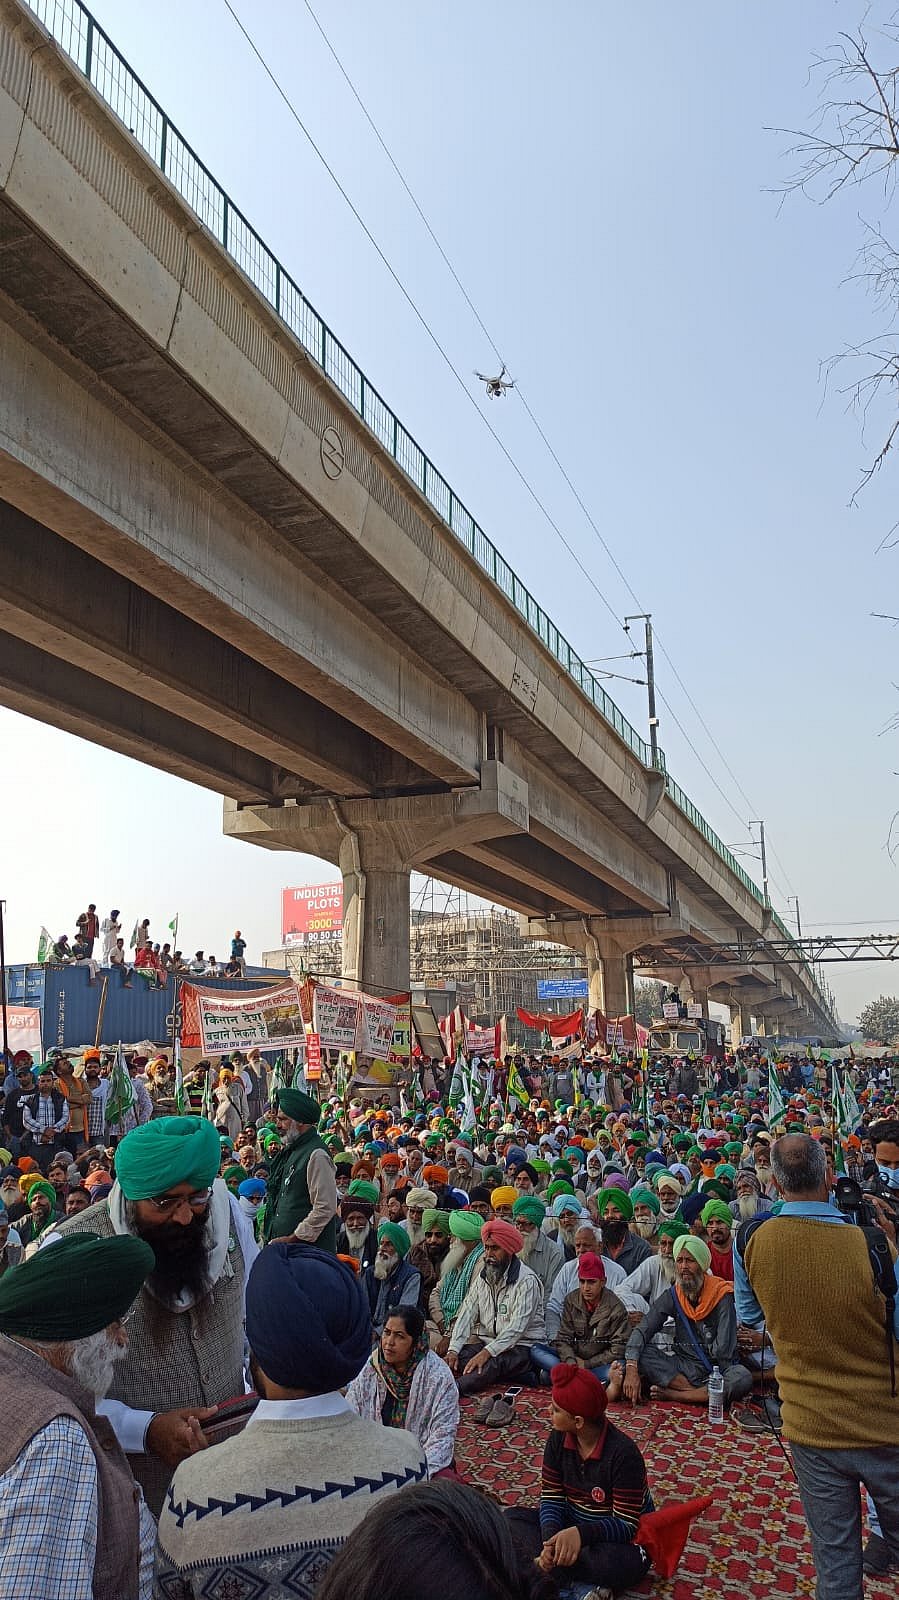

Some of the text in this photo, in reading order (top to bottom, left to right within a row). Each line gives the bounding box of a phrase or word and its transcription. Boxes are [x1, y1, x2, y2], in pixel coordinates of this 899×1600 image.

[294, 886, 343, 900] INDUSTRI
[307, 897, 340, 910] PLOTS
[308, 919, 331, 930] 3000
[308, 932, 318, 941] 90
[320, 931, 330, 939] 50
[204, 1012, 262, 1025] किसान देश
[232, 1026, 257, 1038] निकले
